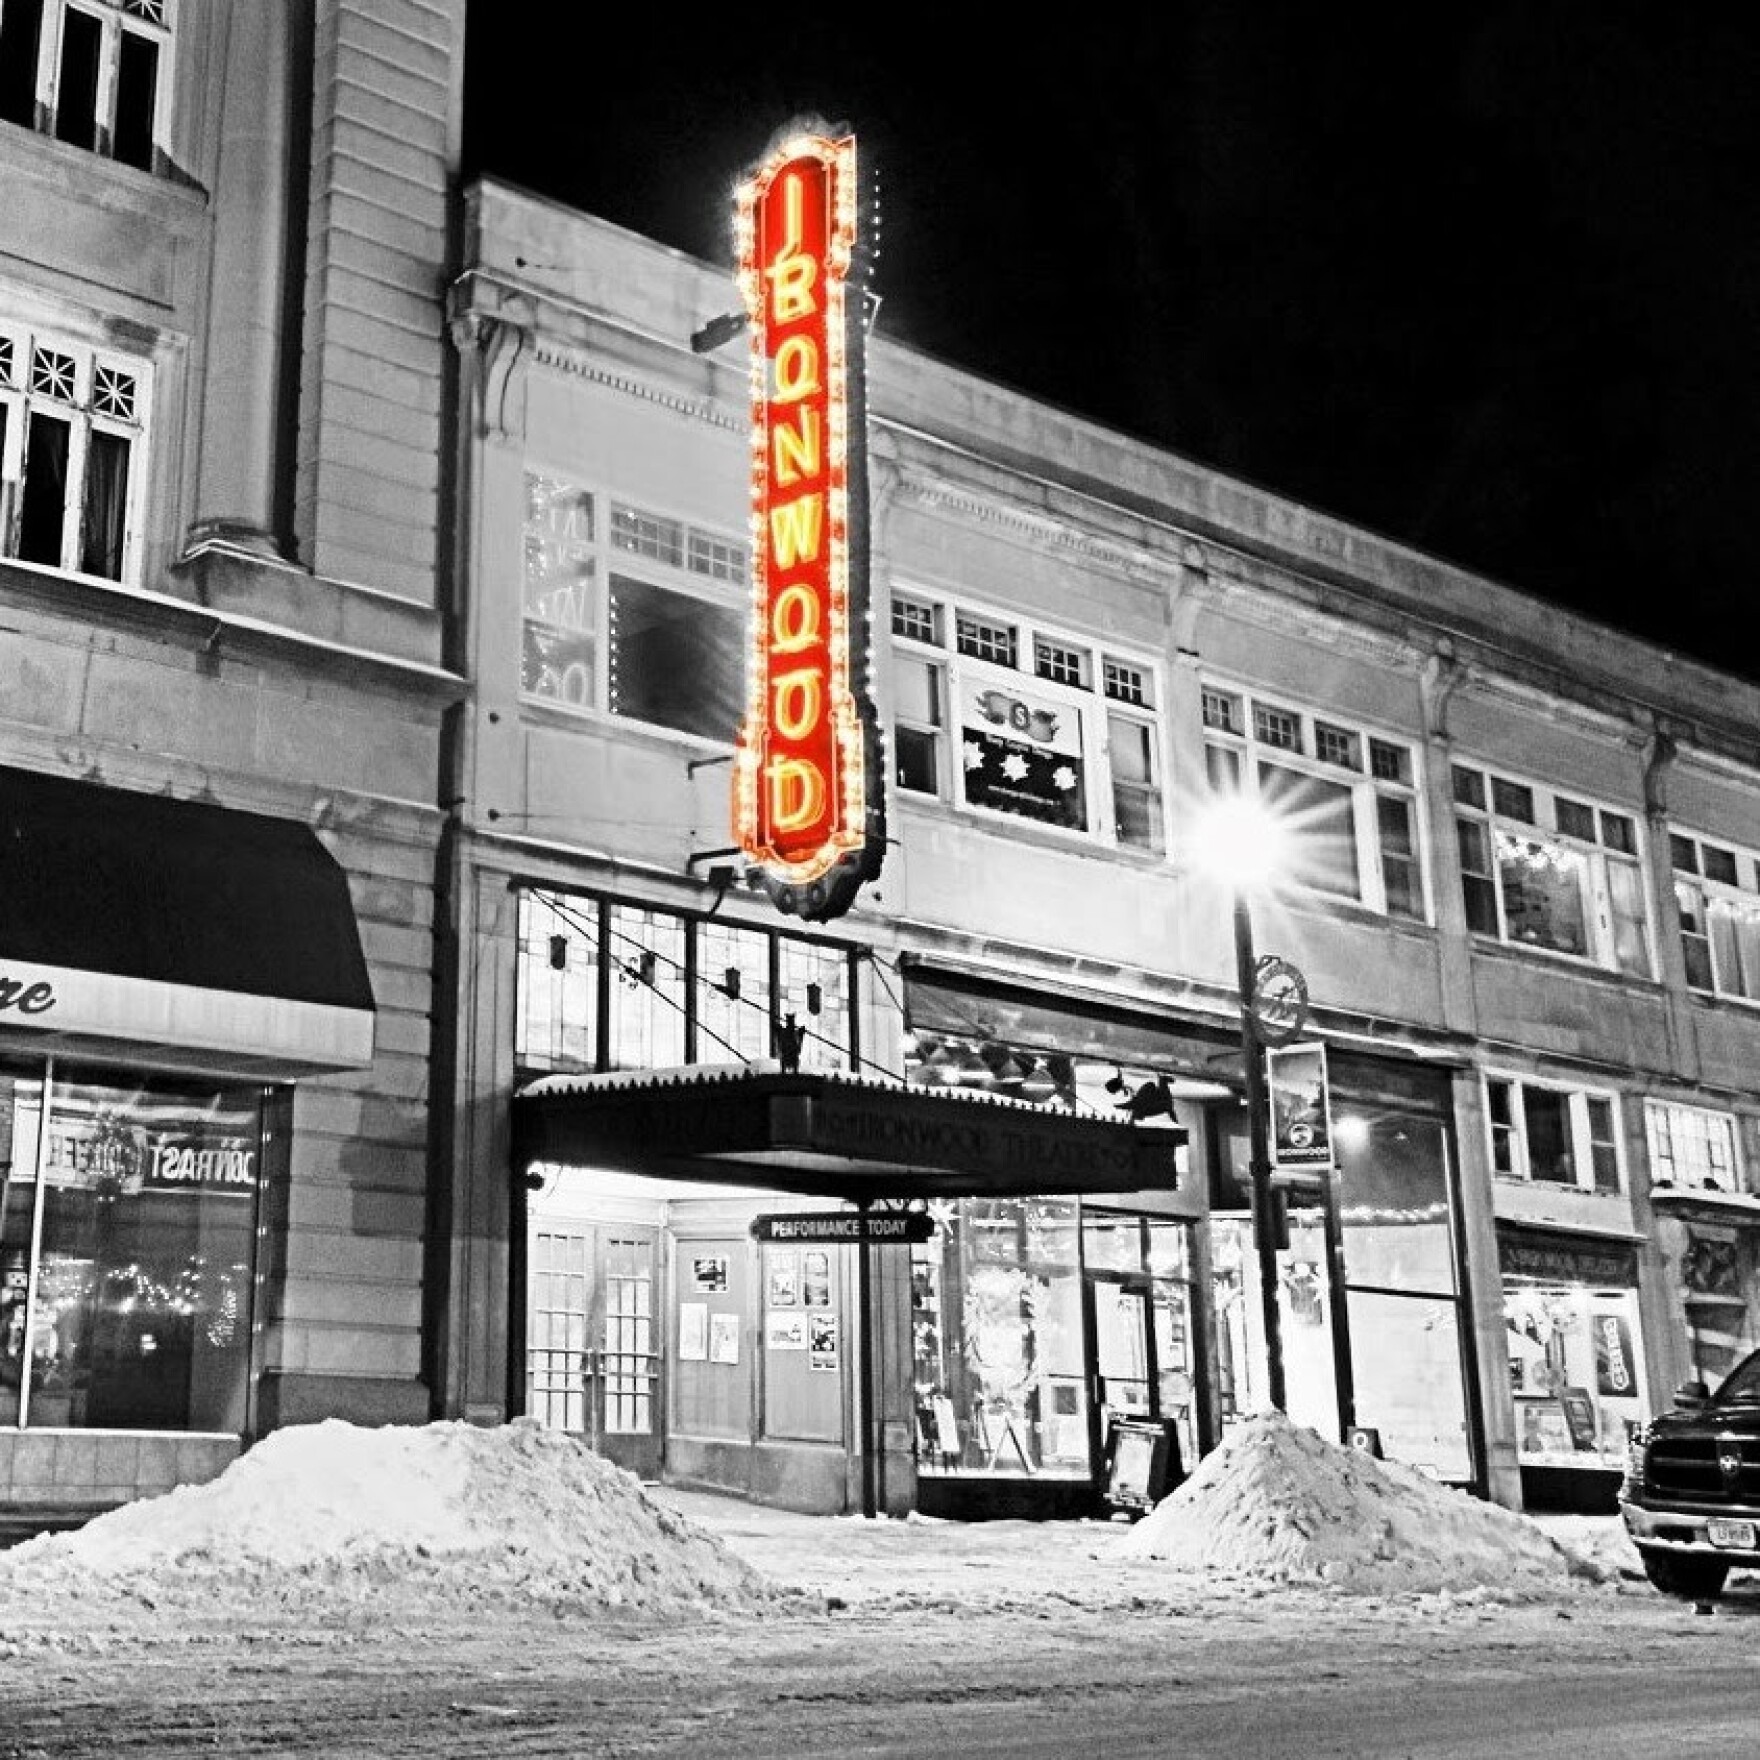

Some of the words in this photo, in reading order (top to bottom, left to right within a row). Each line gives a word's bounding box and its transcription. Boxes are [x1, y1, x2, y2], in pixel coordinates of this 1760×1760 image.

[763, 173, 827, 833] IRONWOOD
[770, 1219, 860, 1238] PERFORMANCE
[866, 1219, 907, 1236] TODAY
